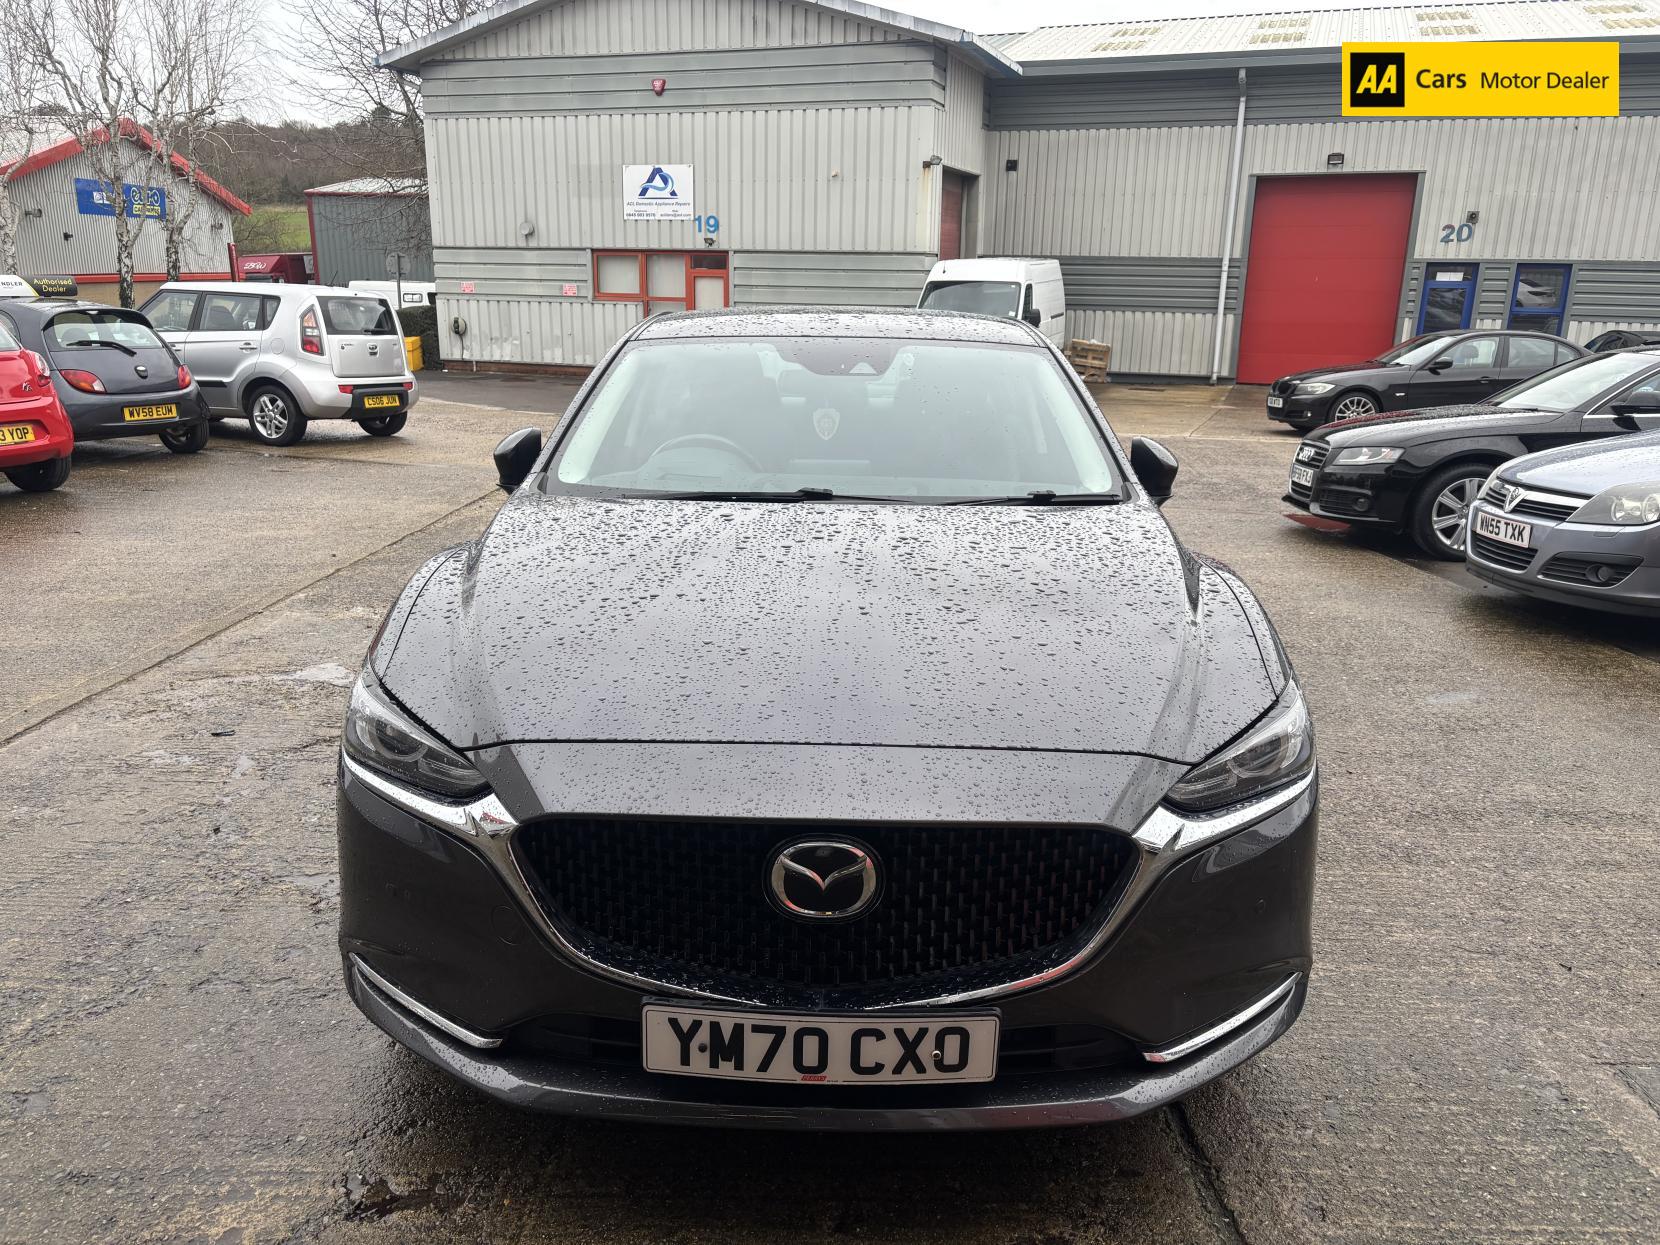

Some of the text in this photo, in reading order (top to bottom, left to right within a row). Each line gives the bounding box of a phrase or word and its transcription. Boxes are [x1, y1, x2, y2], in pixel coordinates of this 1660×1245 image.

[695, 215, 719, 233] 19
[1440, 223, 1472, 242] 20
[128, 405, 173, 419] WV58 EUM
[9, 427, 30, 441] YOP
[1504, 522, 1525, 543] TXK
[667, 1017, 970, 1076] YM70 CXO
